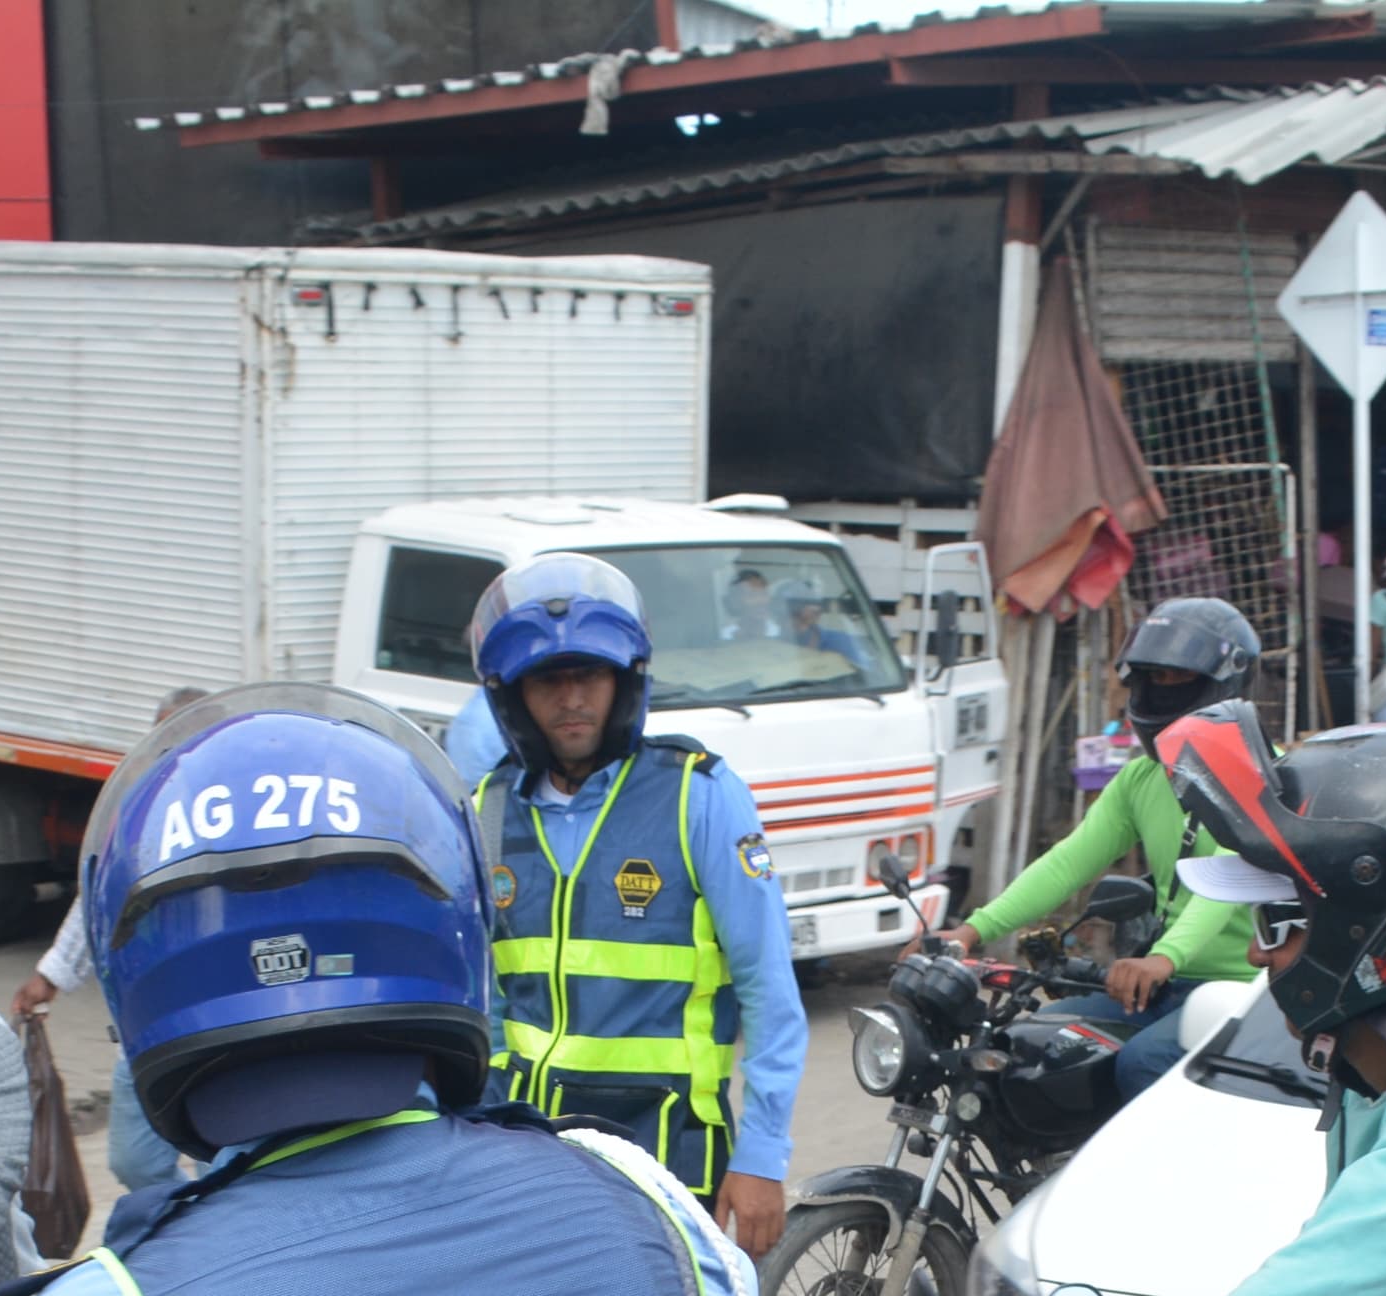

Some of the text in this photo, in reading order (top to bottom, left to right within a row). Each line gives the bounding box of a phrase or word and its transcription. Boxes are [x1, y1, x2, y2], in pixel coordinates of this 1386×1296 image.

[159, 774, 361, 862] AG 275
[620, 874, 655, 889] DATT
[256, 949, 303, 973] DOT
